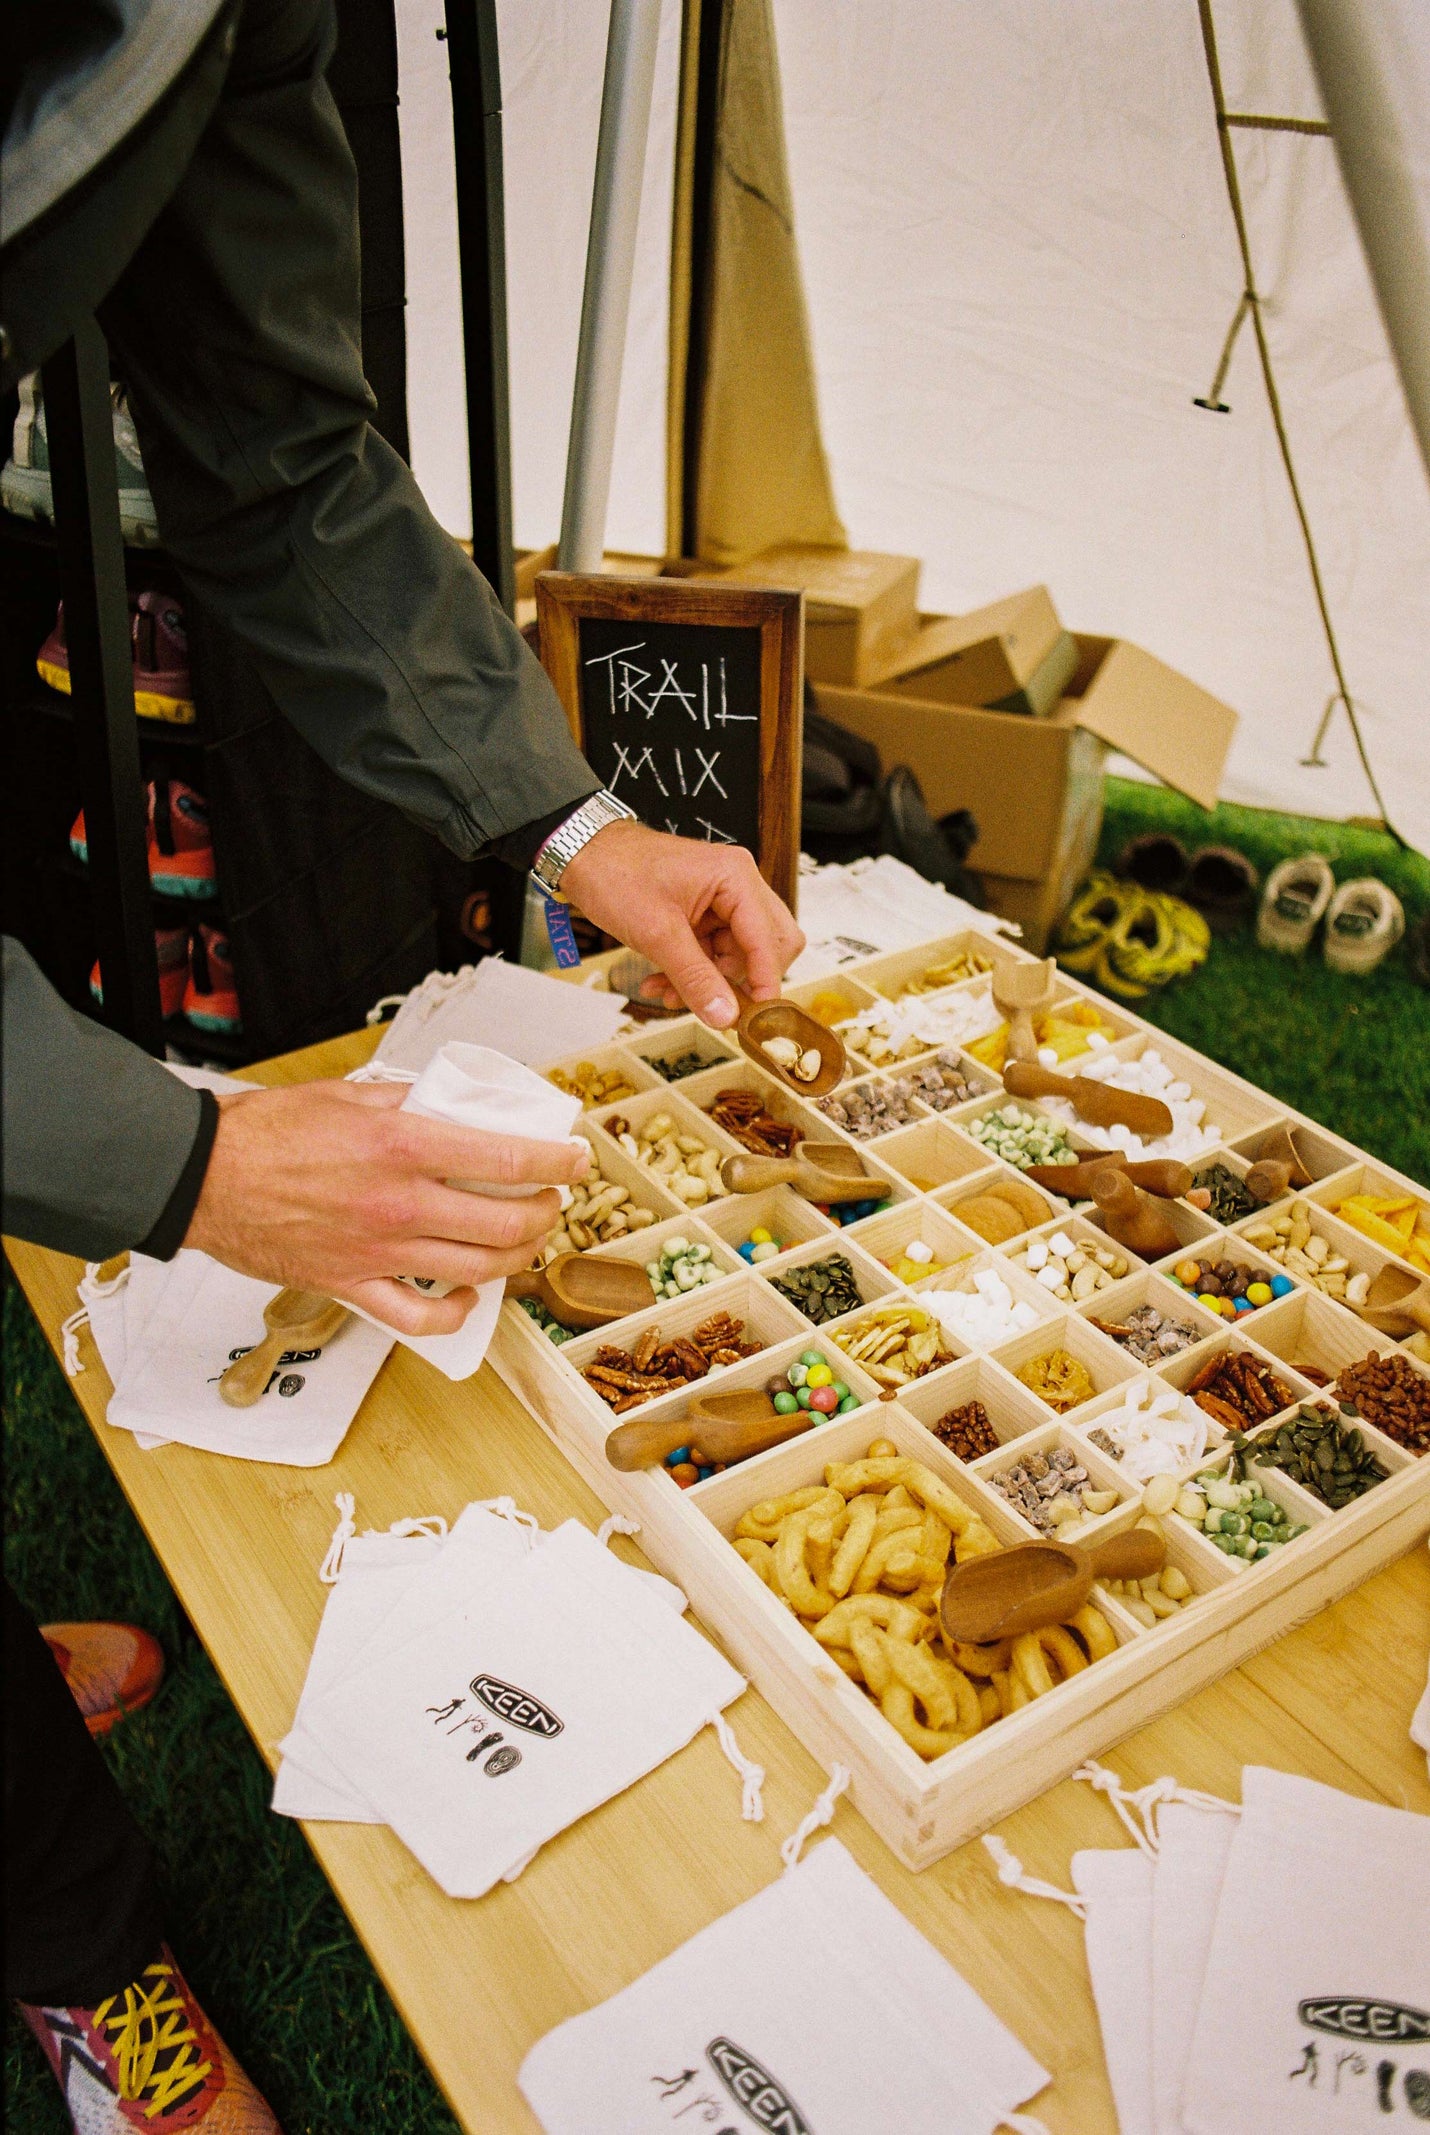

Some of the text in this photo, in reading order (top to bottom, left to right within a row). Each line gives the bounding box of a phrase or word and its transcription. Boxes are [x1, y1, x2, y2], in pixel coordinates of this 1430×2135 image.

[585, 642, 758, 730] TRAIL
[609, 741, 728, 799] MIX
[476, 1679, 558, 1734] KEEN
